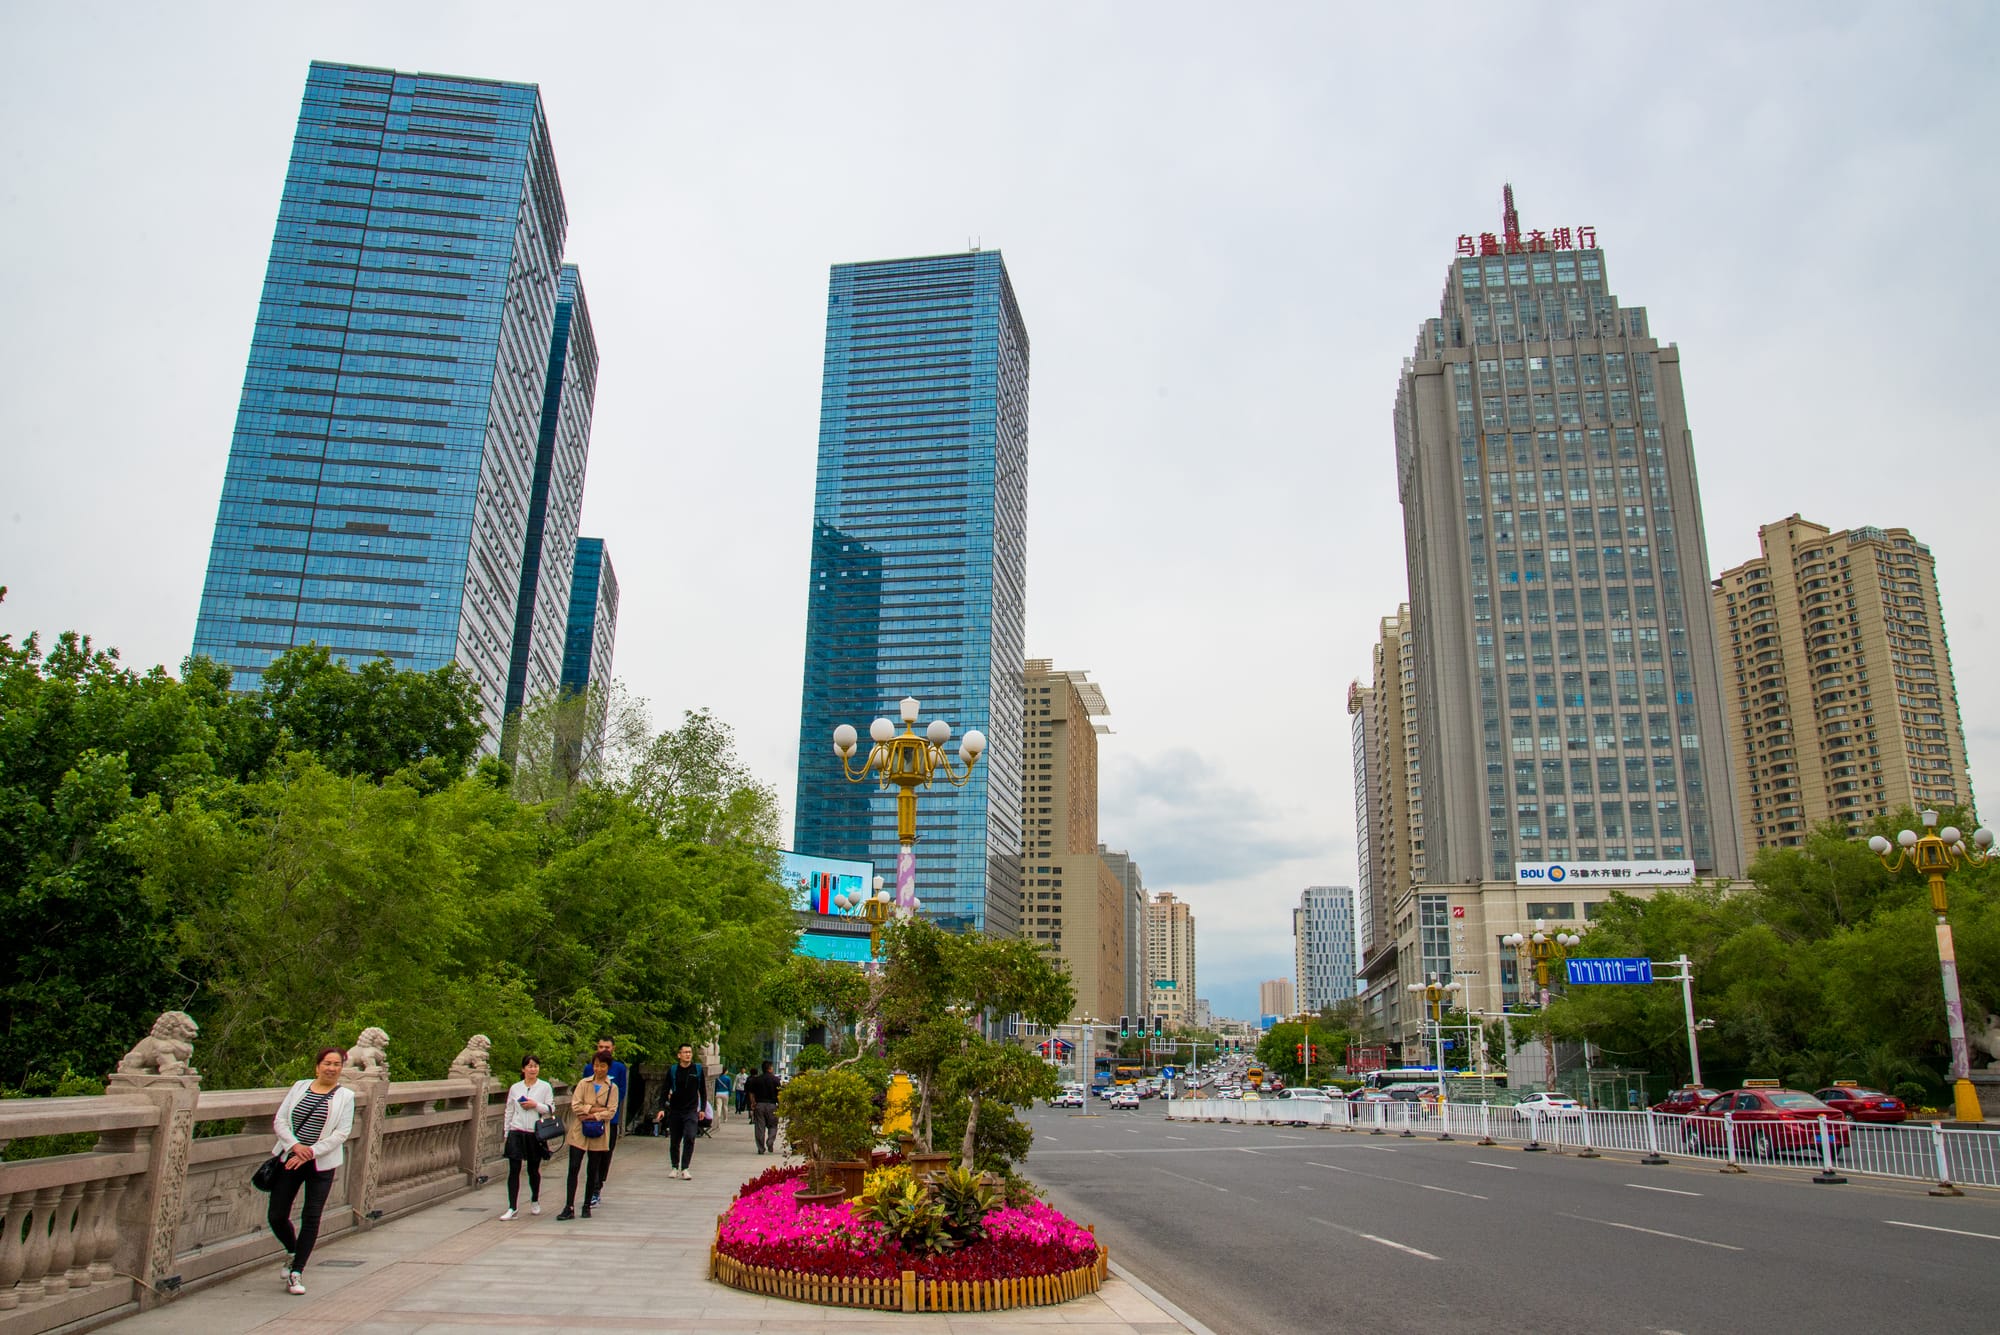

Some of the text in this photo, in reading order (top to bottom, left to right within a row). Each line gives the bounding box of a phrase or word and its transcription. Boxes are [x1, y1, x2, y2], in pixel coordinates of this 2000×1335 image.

[1457, 226, 1596, 256] 乌鲁木齐银行
[1520, 869, 1544, 878] BOU
[1570, 869, 1631, 878] 乌鲁木齐银行
